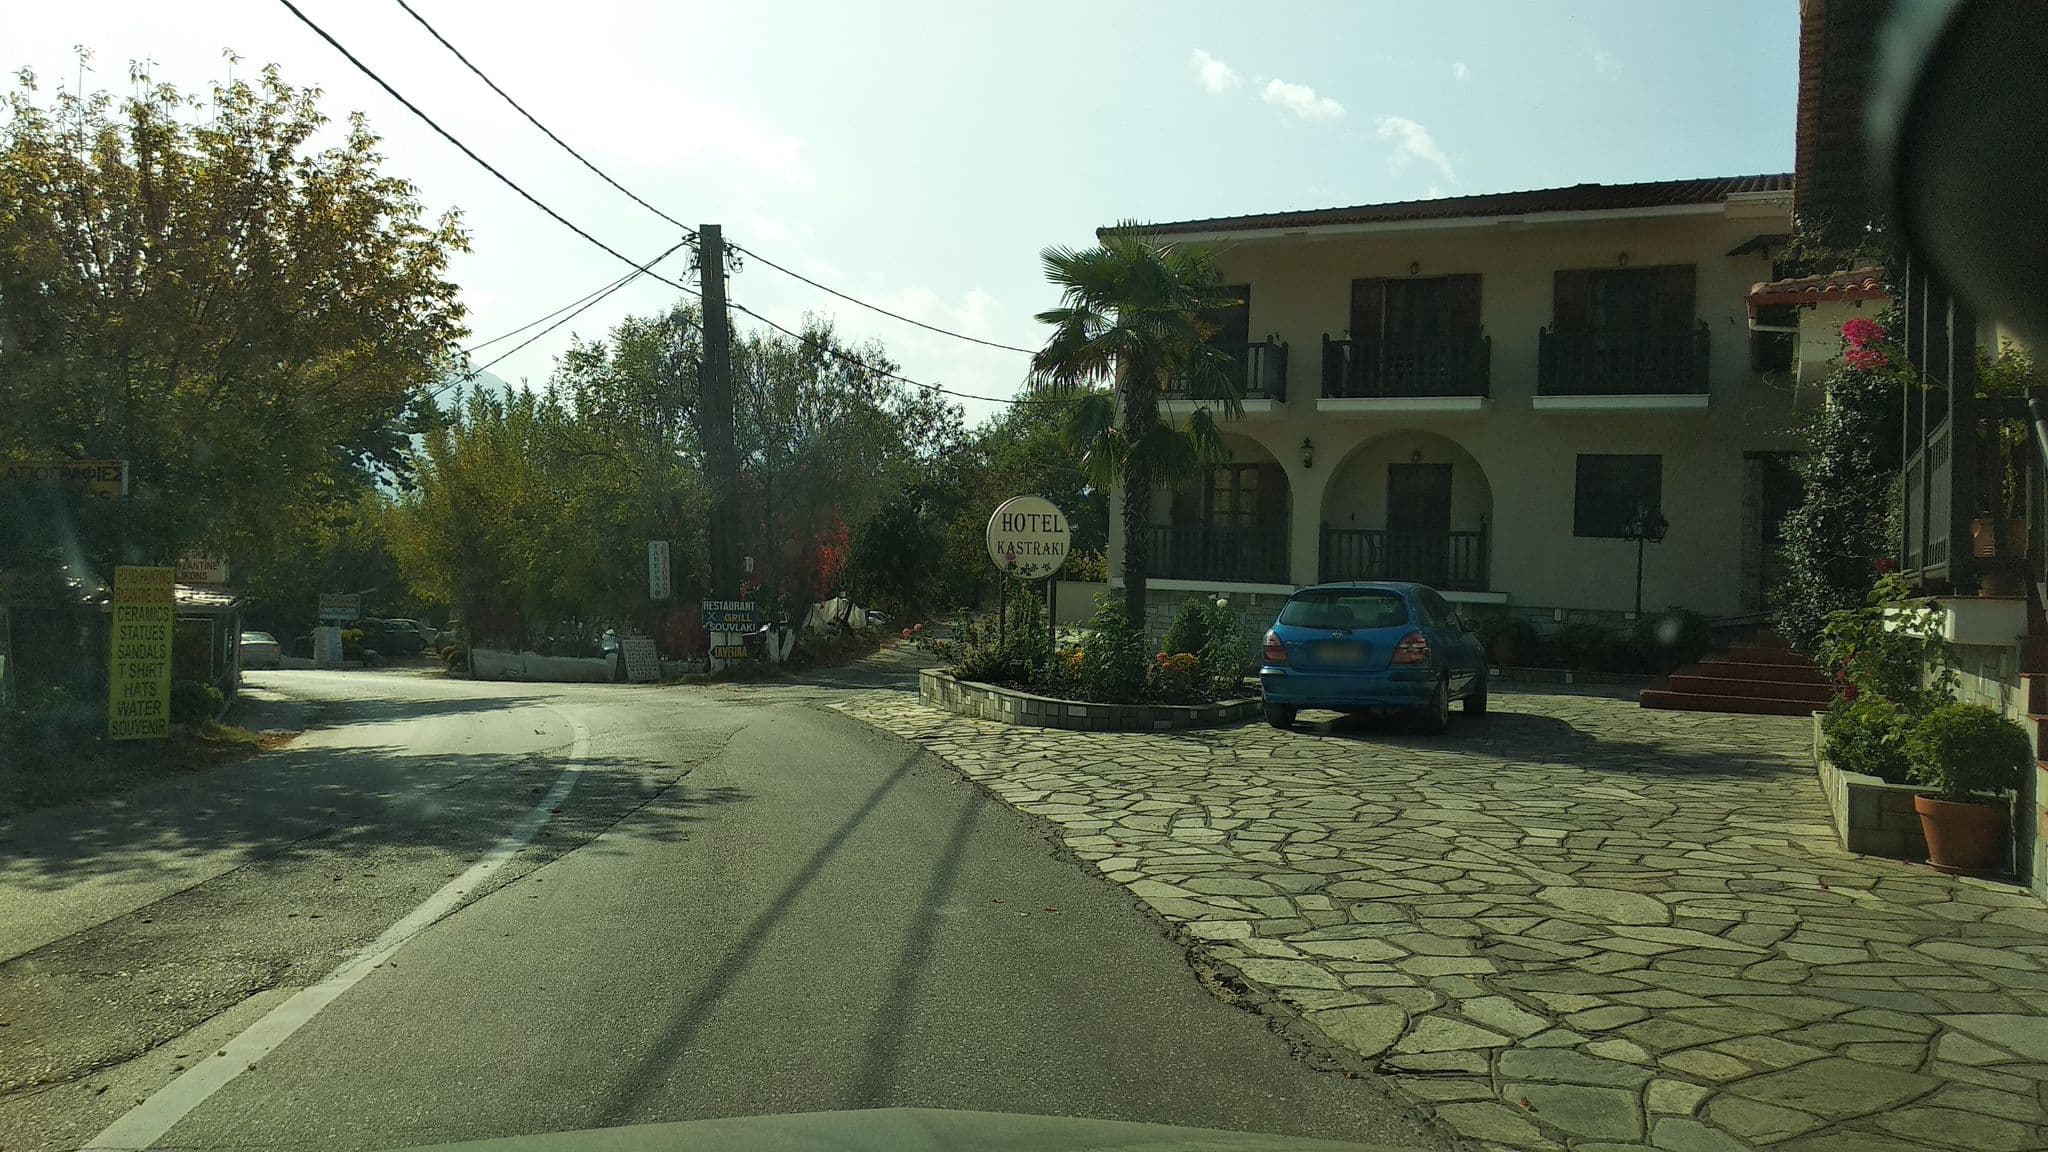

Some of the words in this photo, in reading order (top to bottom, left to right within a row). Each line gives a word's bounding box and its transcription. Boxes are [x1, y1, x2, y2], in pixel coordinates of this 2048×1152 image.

[1002, 513, 1064, 533] HOTEL
[997, 541, 1065, 556] KASTRAKI
[182, 571, 208, 580] IKONS
[703, 600, 756, 611] RESTAURANT
[117, 605, 170, 622] CERAMICS
[724, 613, 753, 622] GRILL
[120, 625, 165, 640] STATUES
[709, 623, 756, 632] SOUVLAKI
[118, 644, 167, 660] SANDALS
[714, 646, 748, 658] TAVERNA
[128, 663, 165, 679] SHIRT
[124, 681, 158, 698] HATS
[117, 700, 162, 717] WATER
[112, 718, 166, 736] SOUVENIR
